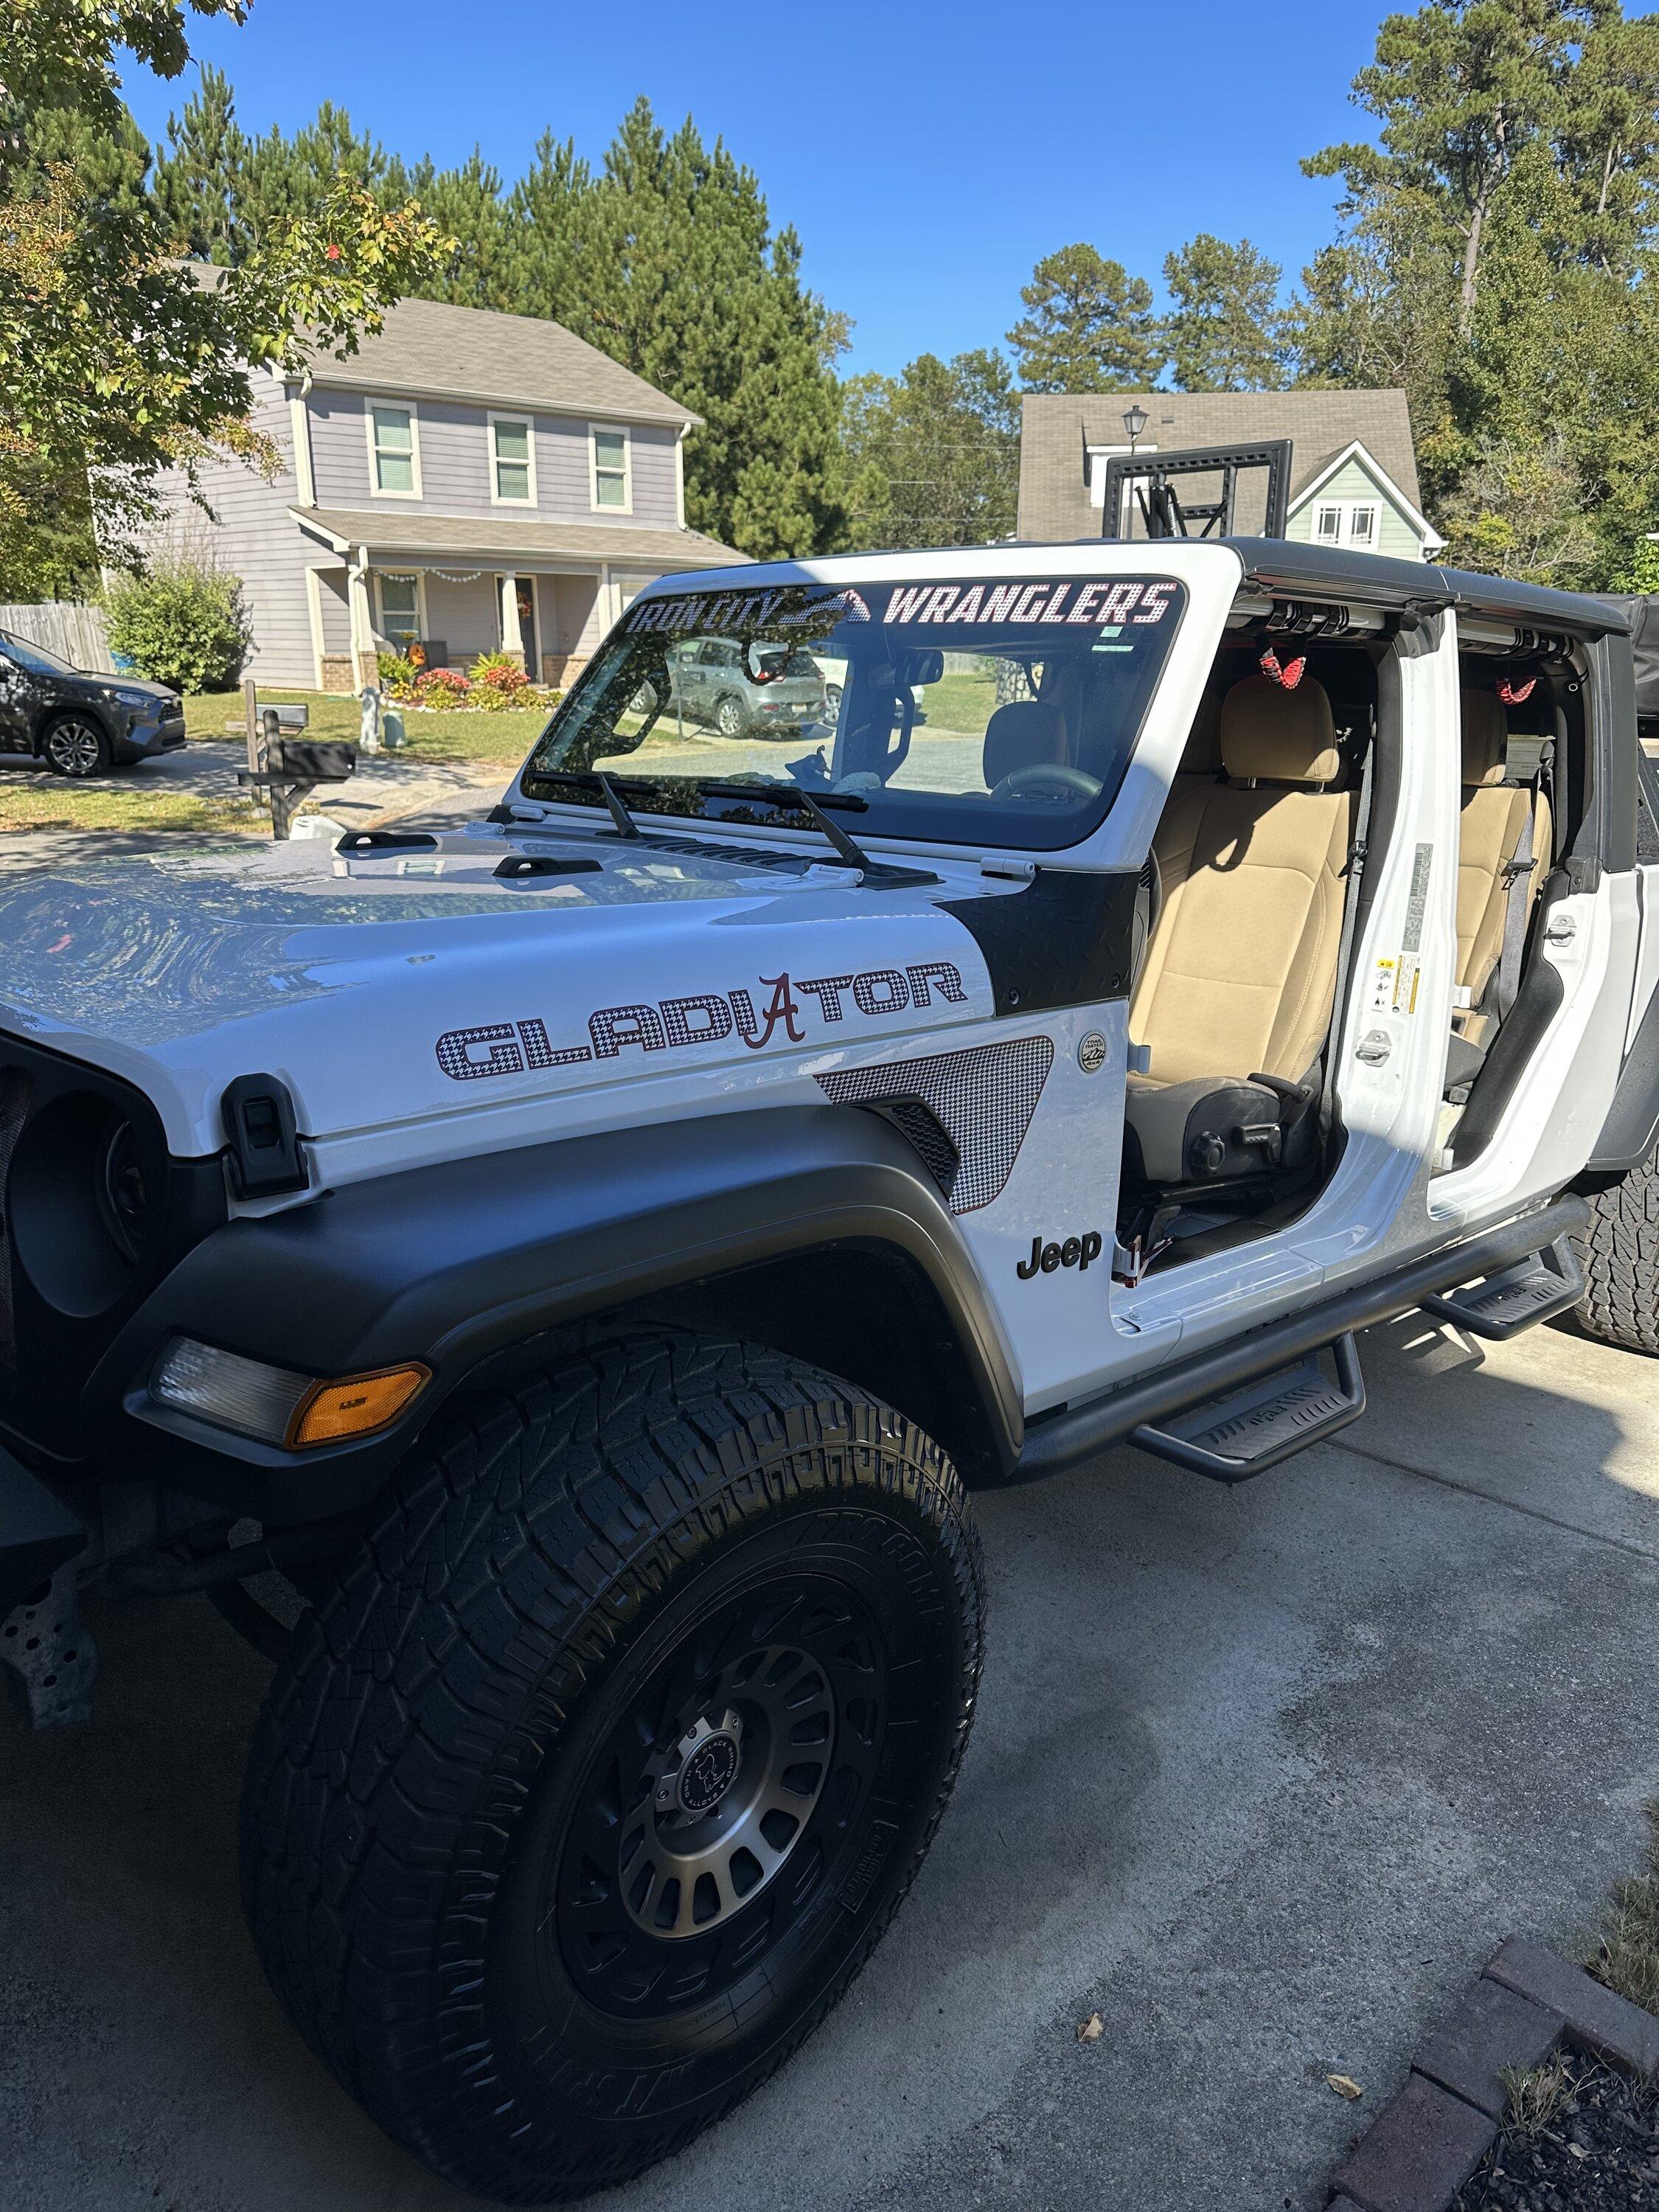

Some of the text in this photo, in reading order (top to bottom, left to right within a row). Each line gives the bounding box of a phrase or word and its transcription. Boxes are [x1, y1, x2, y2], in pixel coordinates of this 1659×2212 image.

[626, 582, 1178, 633] IRON CITY WRANGLERS
[435, 961, 970, 1081] GLADIATOR
[1017, 1231, 1102, 1280] Jeep
[703, 1740, 736, 1778] BLACK RHINO
[684, 1770, 718, 1806] HARD ALLOYS
